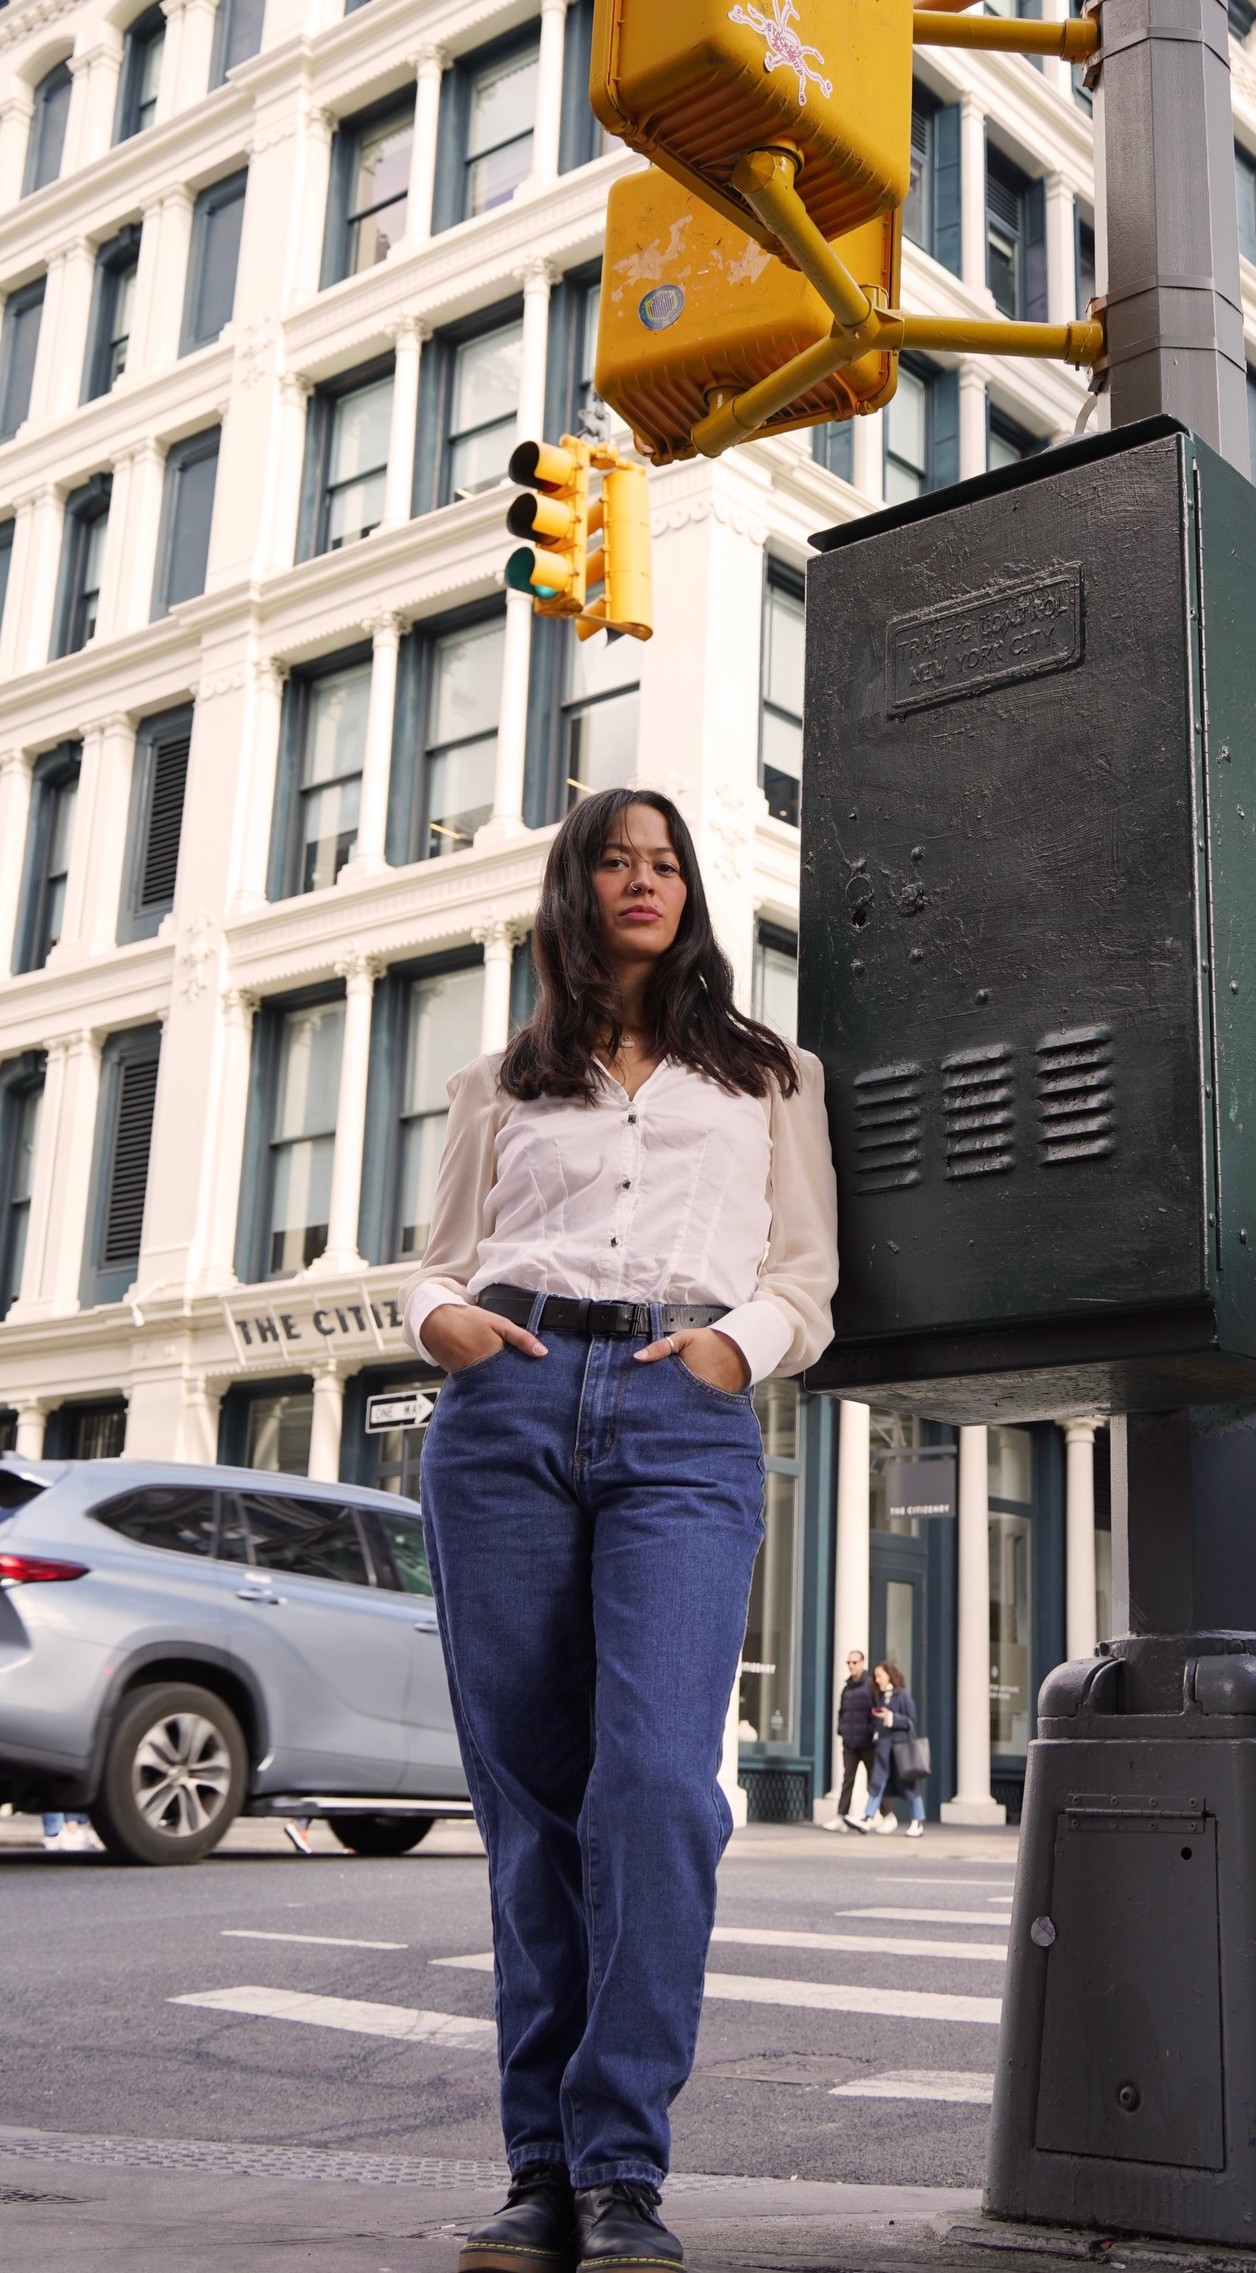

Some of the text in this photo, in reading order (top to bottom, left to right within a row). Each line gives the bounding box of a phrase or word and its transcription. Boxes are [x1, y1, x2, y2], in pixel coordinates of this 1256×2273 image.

[898, 595, 1068, 661] TRAFFIC CONTROL
[909, 625, 1055, 687] NEW YORK CITY
[235, 1301, 402, 1345] THE CITIZ
[375, 1405, 392, 1419] ONE
[890, 1506, 905, 1516] THE
